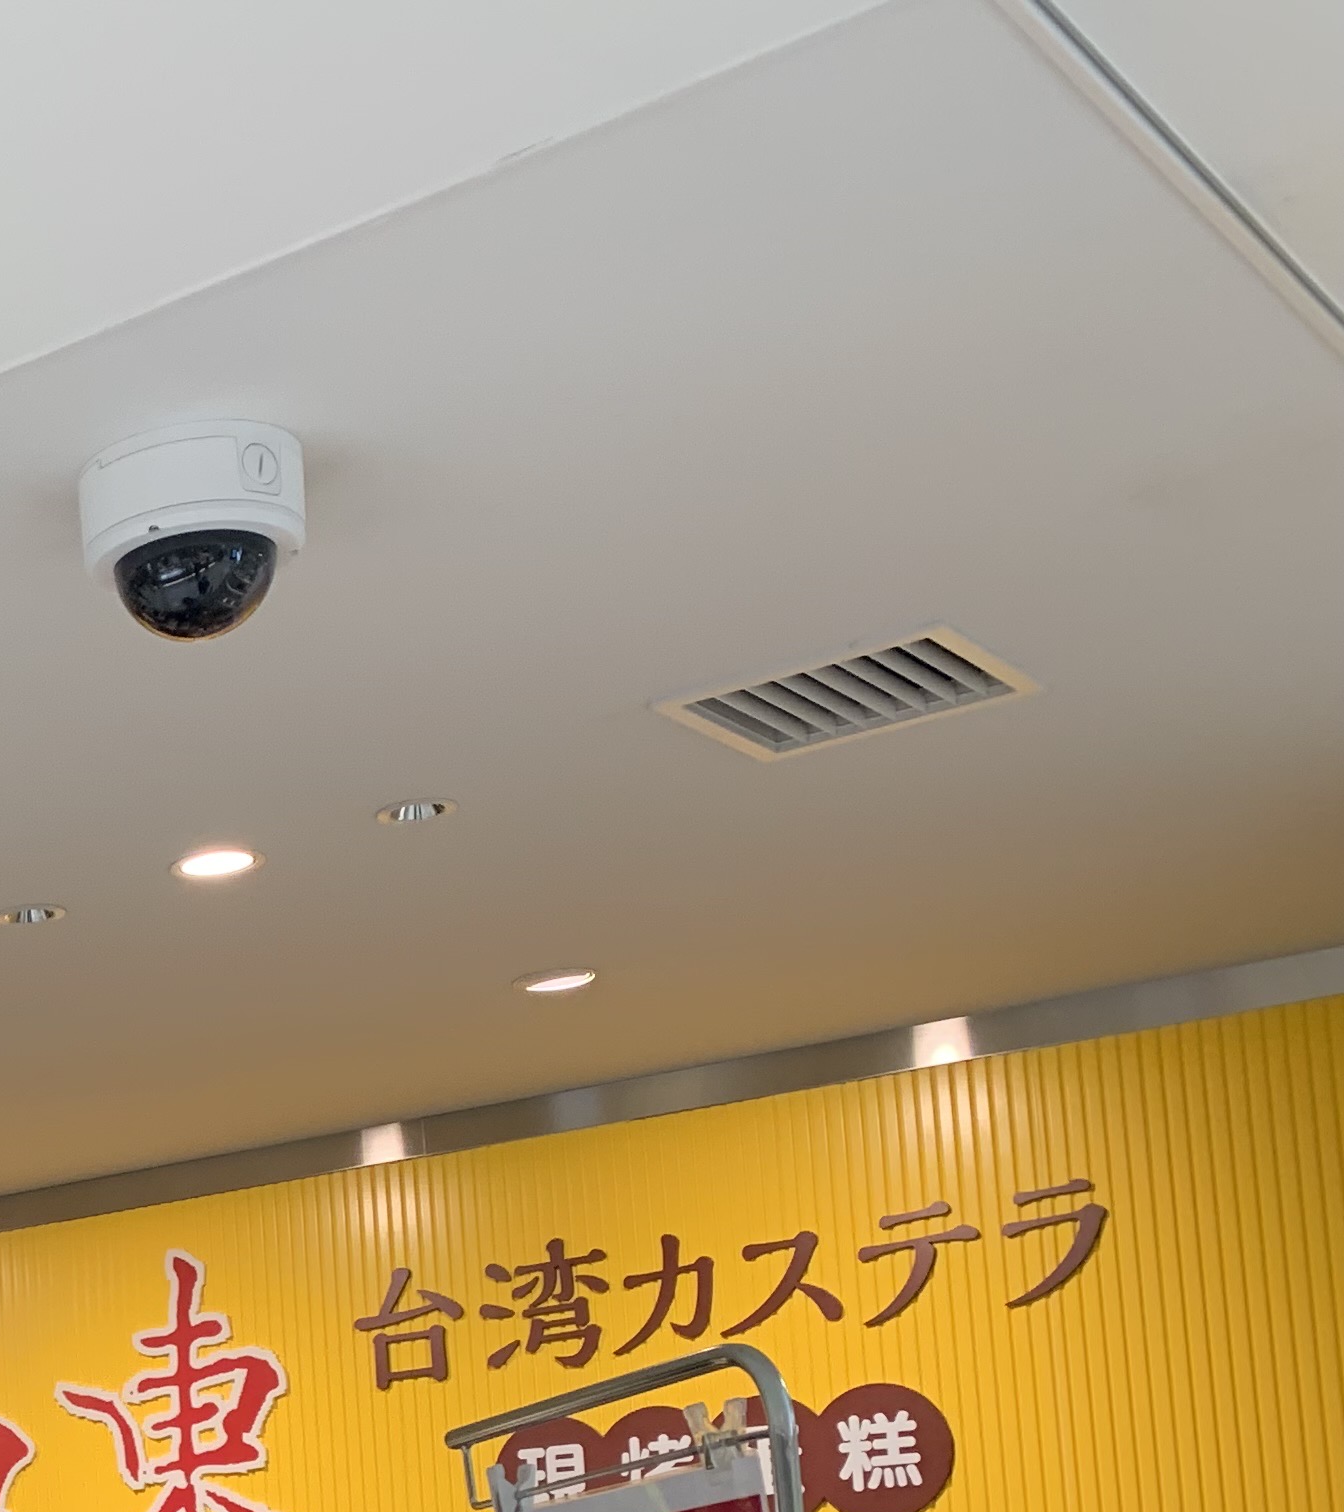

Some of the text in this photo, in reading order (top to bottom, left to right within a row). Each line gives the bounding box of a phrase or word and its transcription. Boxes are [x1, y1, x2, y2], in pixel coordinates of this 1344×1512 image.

[354, 1178, 1110, 1391] 台湾カステラ
